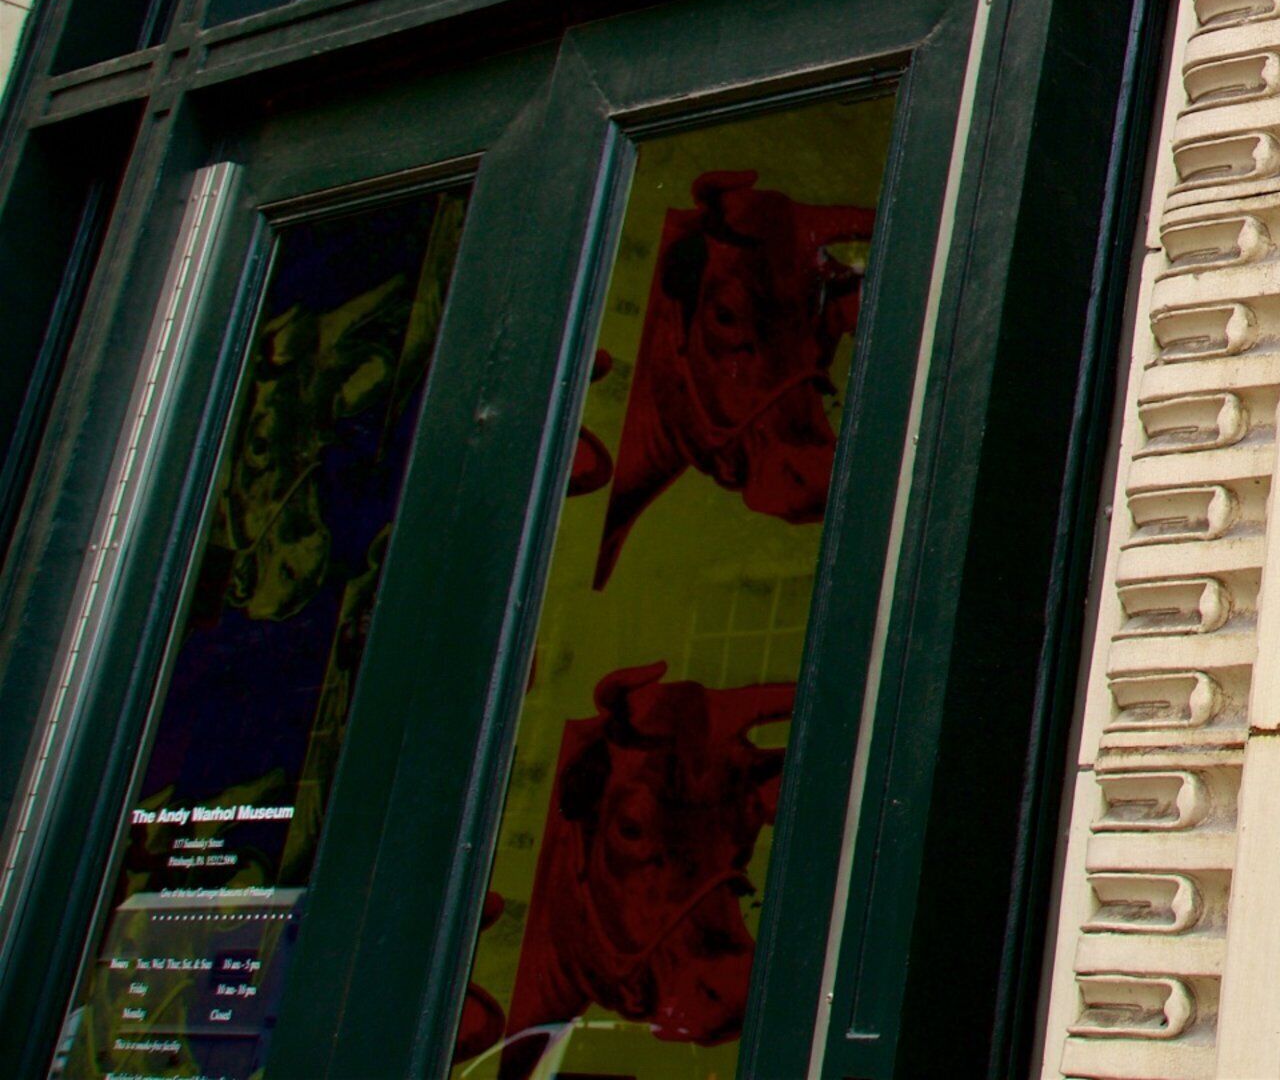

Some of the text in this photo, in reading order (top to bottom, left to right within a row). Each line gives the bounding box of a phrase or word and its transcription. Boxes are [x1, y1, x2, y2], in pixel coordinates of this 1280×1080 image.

[132, 805, 294, 825] The Andy Warhol Museum
